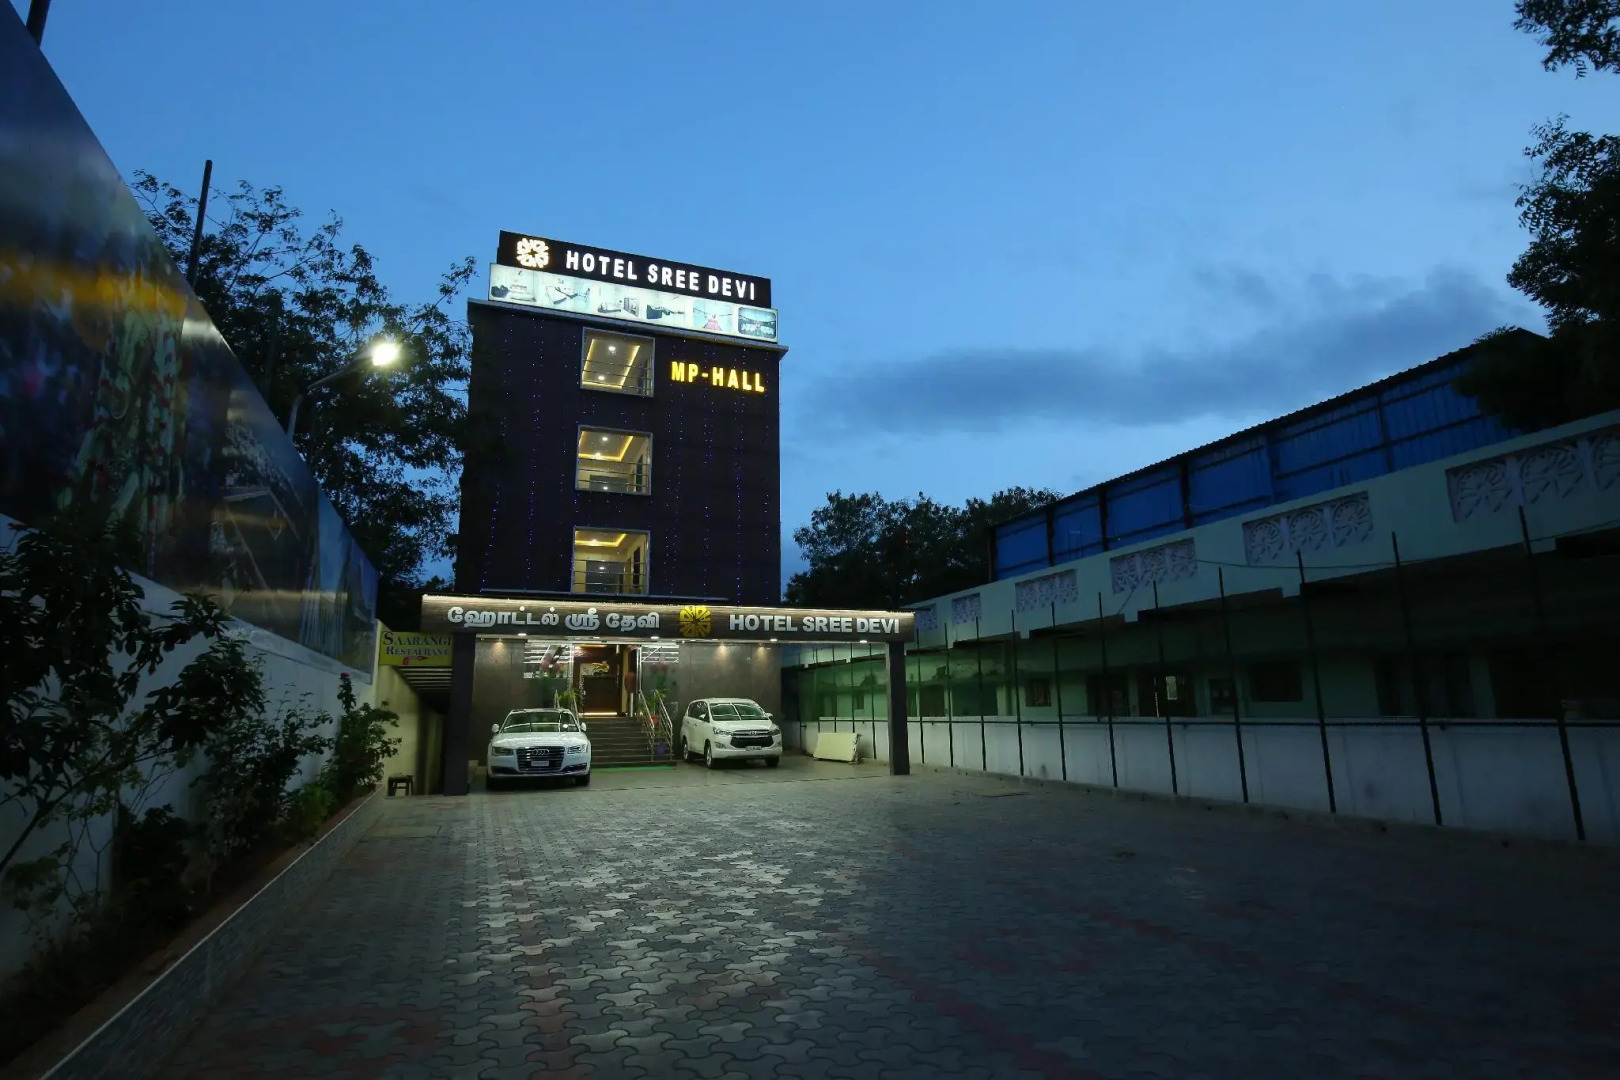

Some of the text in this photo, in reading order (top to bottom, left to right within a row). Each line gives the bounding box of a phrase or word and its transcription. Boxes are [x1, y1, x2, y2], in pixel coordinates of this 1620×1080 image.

[565, 250, 756, 301] HOTEL SREE DEVI
[670, 360, 766, 393] MP-HALL
[447, 605, 560, 628] ஹோட்டல்
[605, 611, 660, 632] தேவி
[729, 614, 900, 634] HOTEL SREE DEVI
[383, 631, 451, 646] SAARANGI
